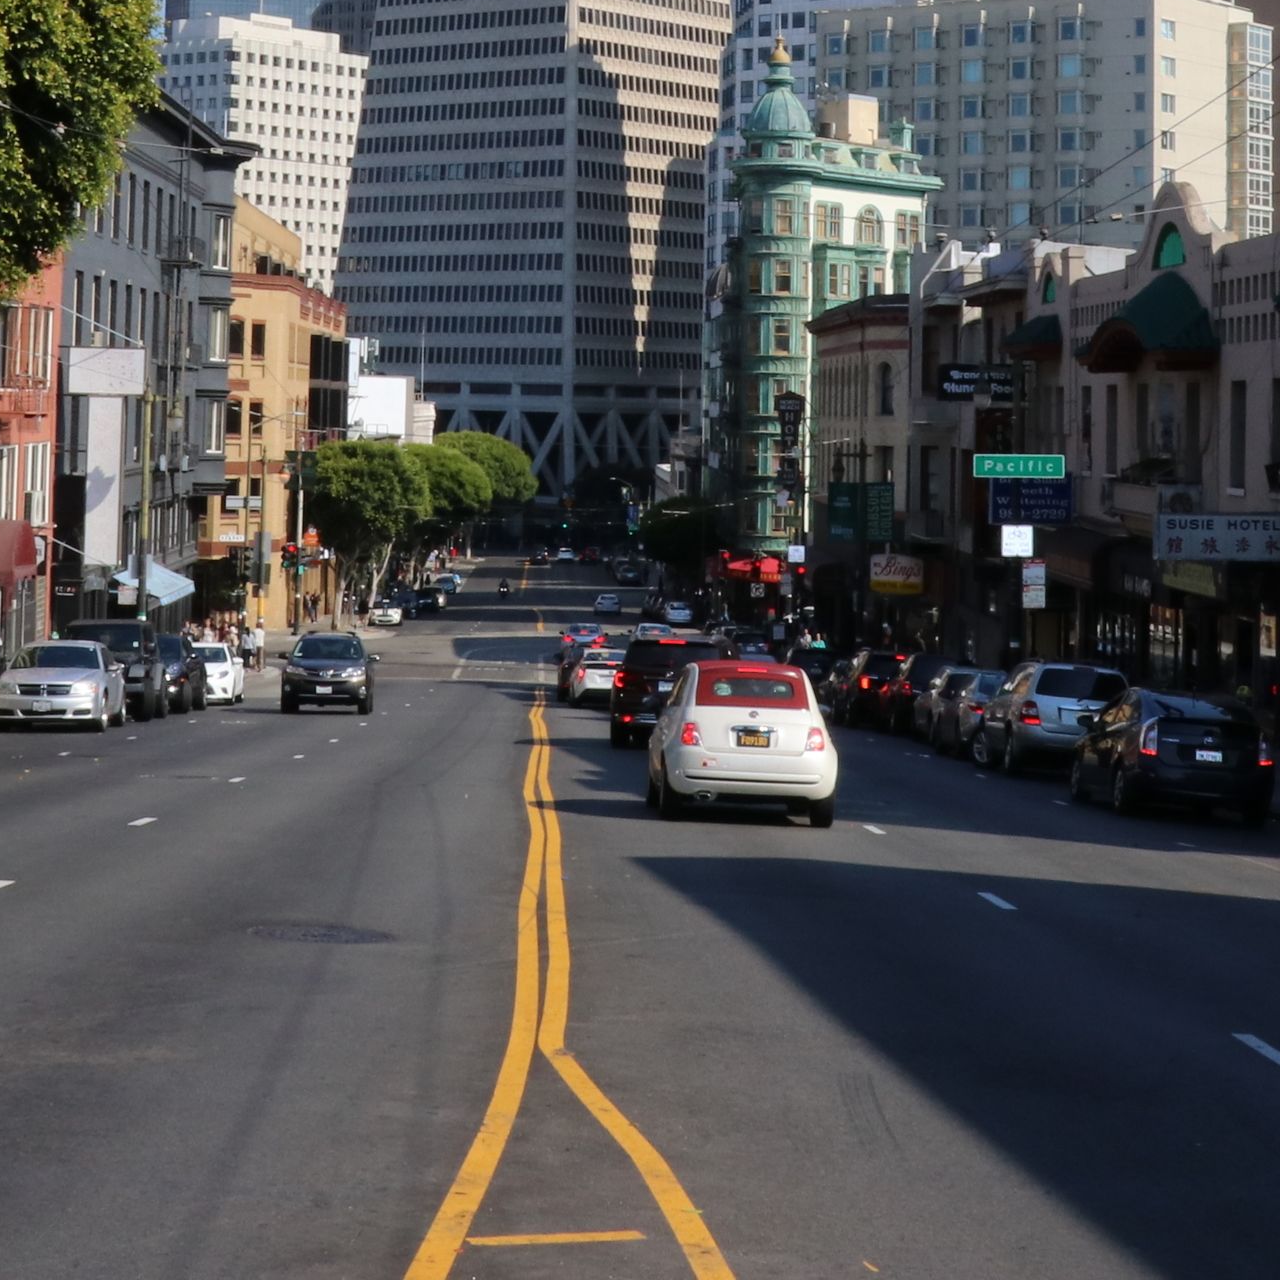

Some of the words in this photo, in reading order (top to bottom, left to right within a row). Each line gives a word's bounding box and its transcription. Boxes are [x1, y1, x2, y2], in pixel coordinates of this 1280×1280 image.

[991, 383, 1014, 395] Foo
[983, 459, 1055, 473] Pacific
[1020, 486, 1054, 496] eeth
[996, 496, 1070, 507] Witening
[1166, 519, 1214, 530] SUSIE
[1227, 519, 1280, 531] HOTEL
